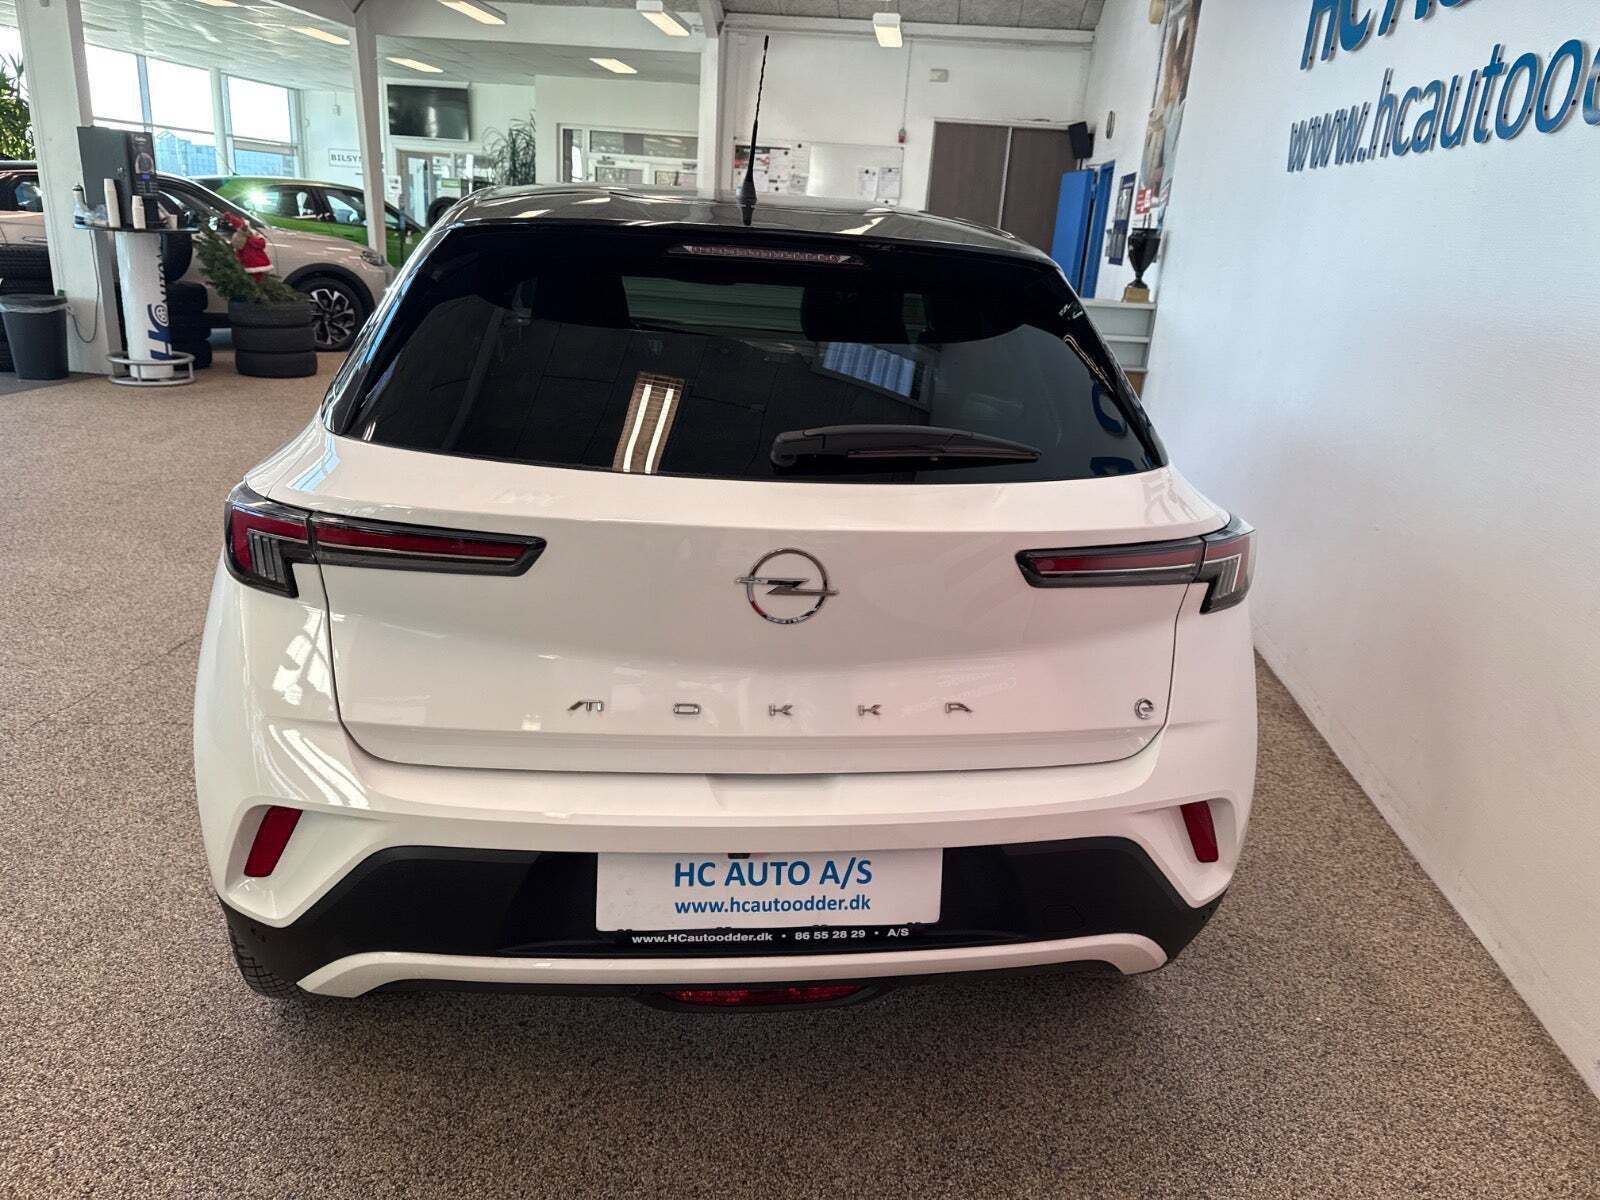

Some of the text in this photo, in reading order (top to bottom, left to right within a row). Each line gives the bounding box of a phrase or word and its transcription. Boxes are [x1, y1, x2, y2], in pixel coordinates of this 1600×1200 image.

[331, 153, 362, 162] BILSY
[568, 700, 974, 717] MOKKA
[674, 857, 873, 889] HC AUTO A/S
[675, 894, 871, 914] www.hcautoodder.dk
[631, 928, 910, 944] www.HCautoodder.dk 86 55 28 29 A/S
